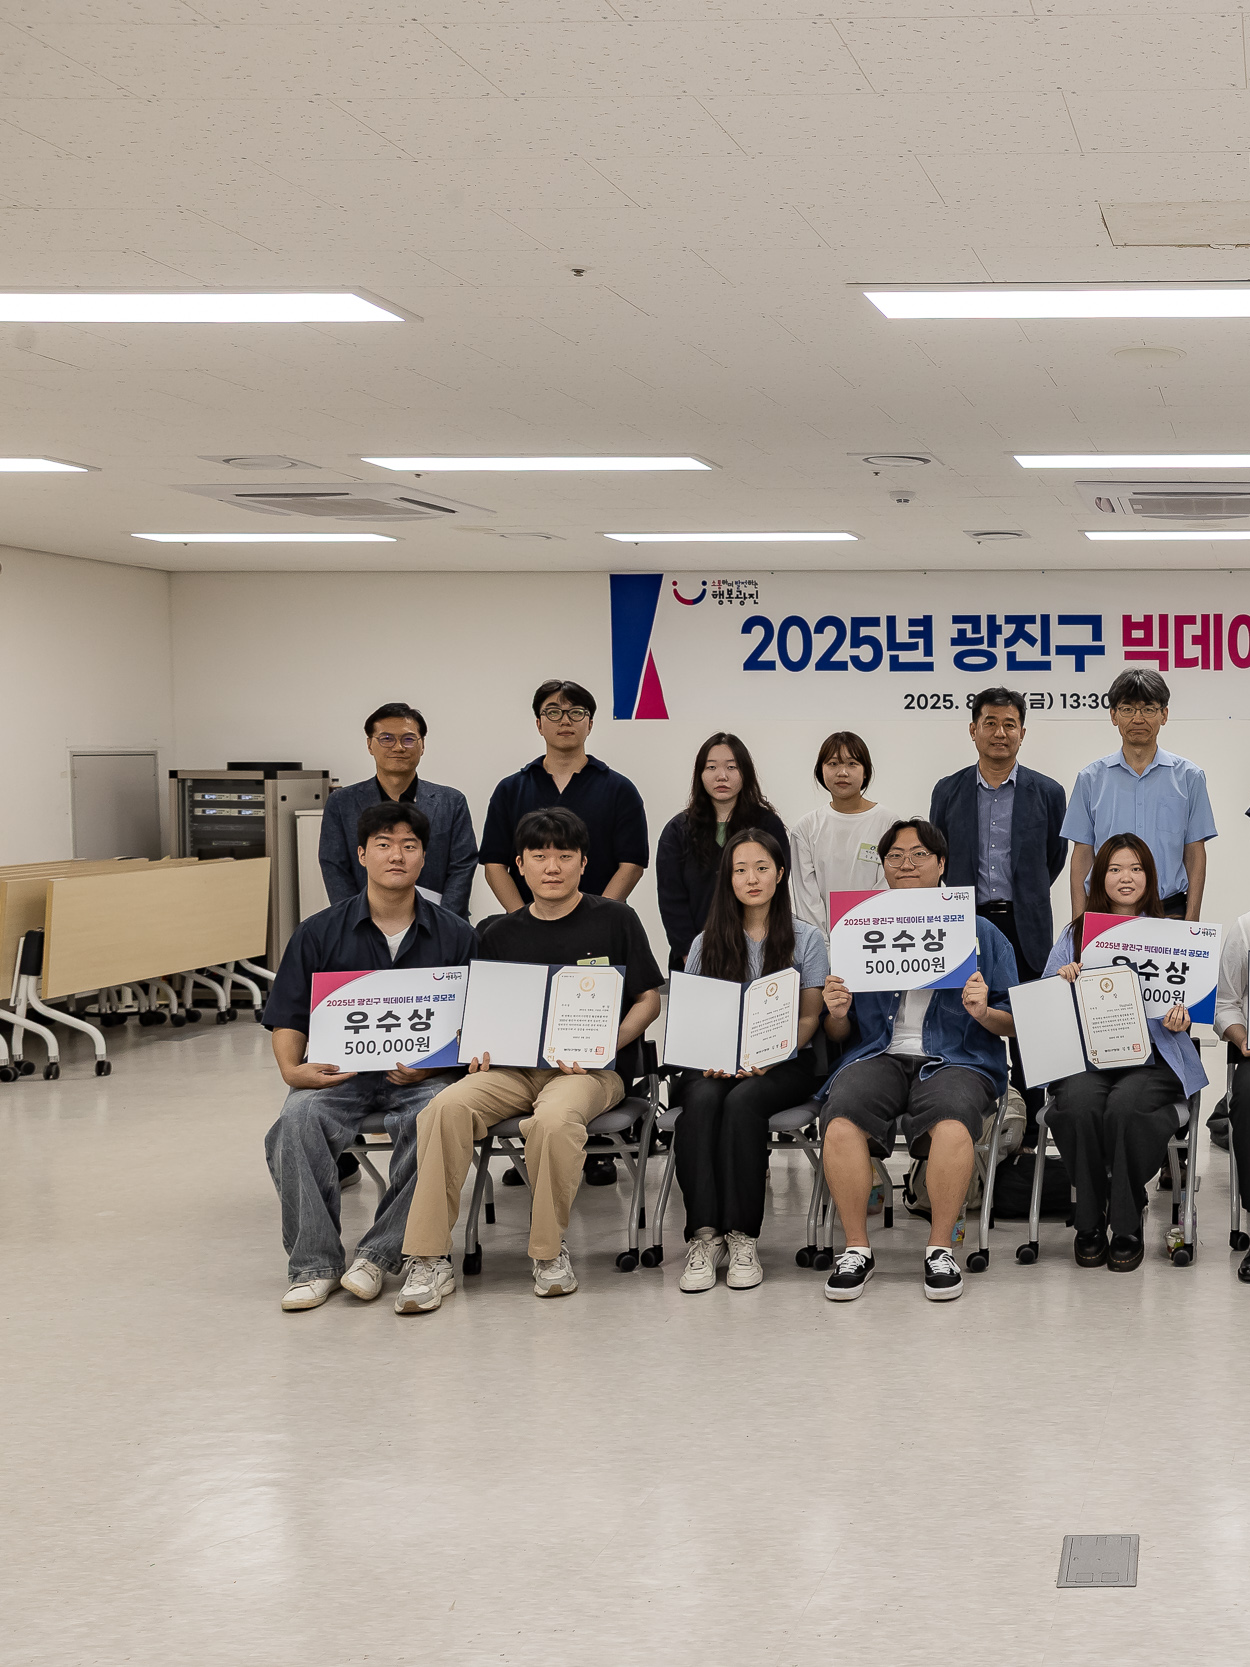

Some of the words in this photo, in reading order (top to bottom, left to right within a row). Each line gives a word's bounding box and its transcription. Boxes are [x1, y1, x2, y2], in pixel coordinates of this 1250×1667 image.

[711, 589, 759, 606] 행복광진
[740, 614, 934, 672] 2025년
[950, 614, 1105, 672] 광진구
[904, 693, 959, 710] 2025.
[844, 917, 870, 926] 2025년
[872, 917, 894, 925] 광진구
[896, 915, 925, 924] 빅데이터
[943, 914, 964, 922] 공모전
[863, 929, 946, 953] 우수상
[1095, 941, 1120, 950] 2025년
[1122, 943, 1142, 952] 광진구
[1144, 945, 1171, 955] 빅데이터
[1188, 950, 1209, 958] 공모전
[865, 957, 945, 975] 500,000원
[327, 999, 355, 1007] 2025년
[357, 998, 381, 1006] 광진구
[383, 996, 413, 1004] 빅데이터
[432, 994, 455, 1002] 공모전
[344, 1008, 434, 1034] 우수상
[344, 1036, 430, 1055] 500,000원
